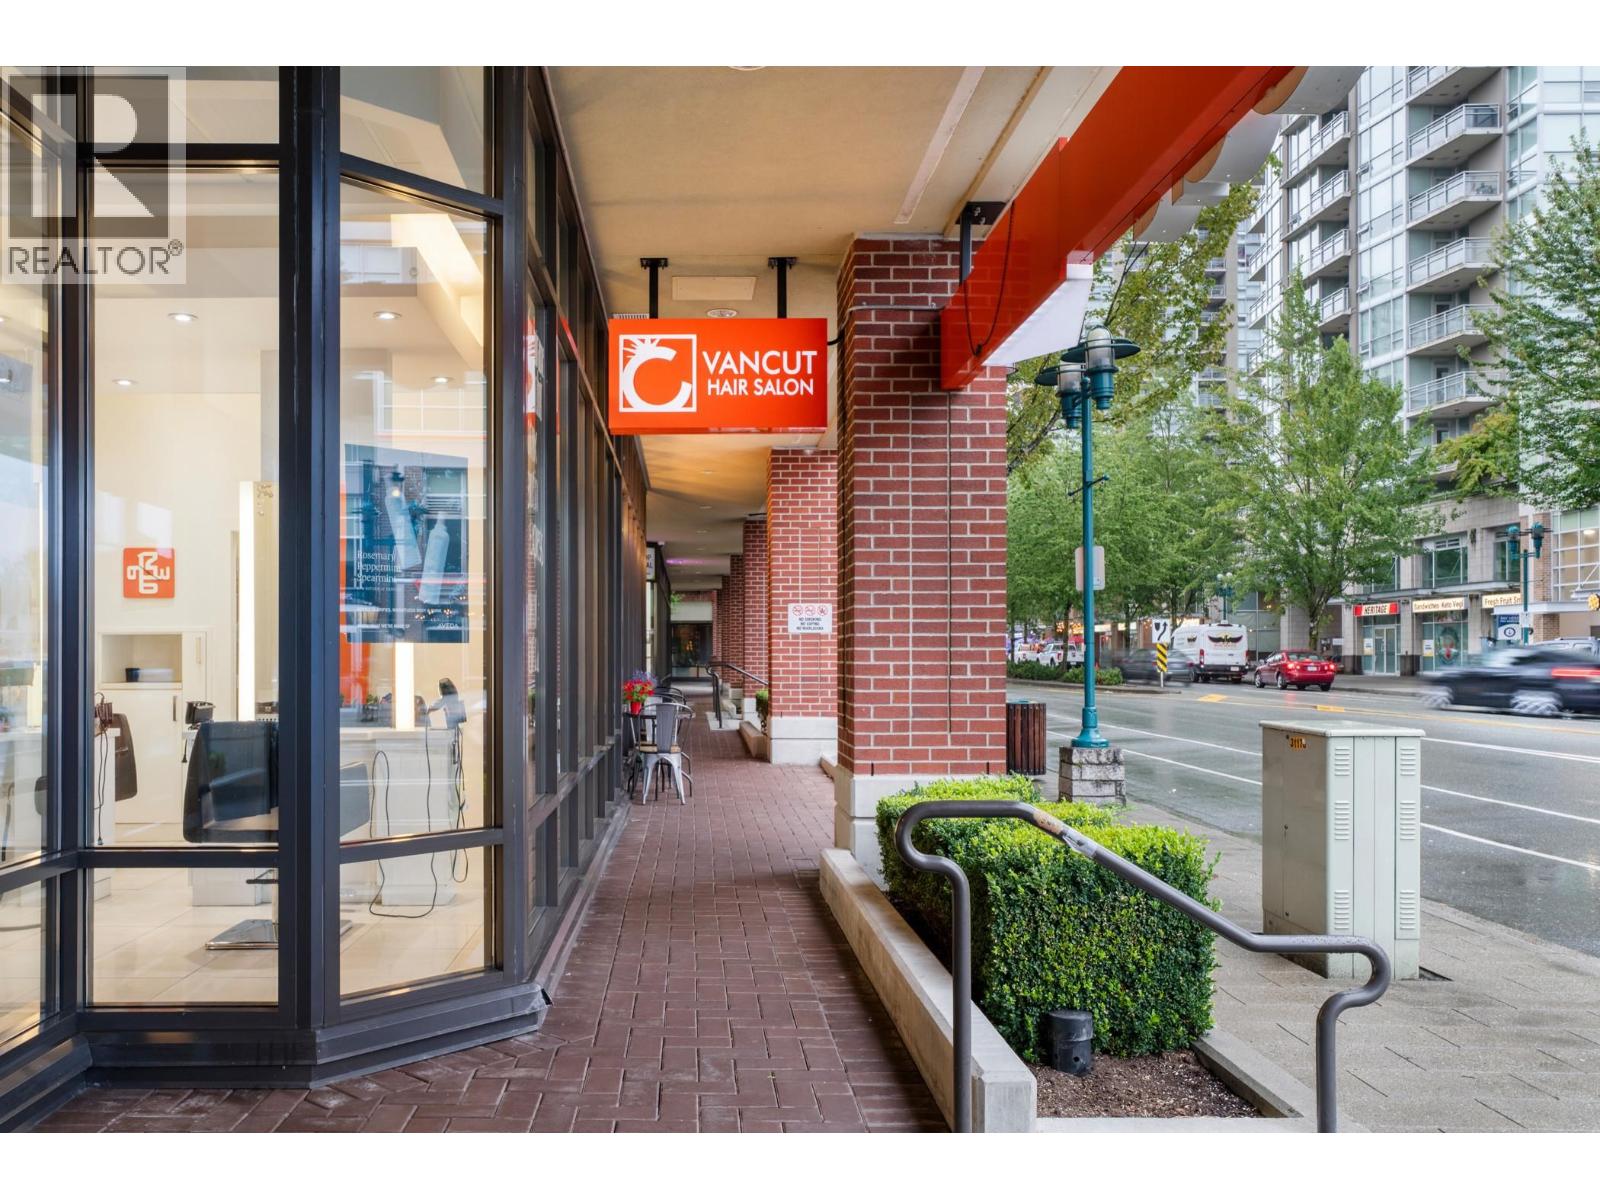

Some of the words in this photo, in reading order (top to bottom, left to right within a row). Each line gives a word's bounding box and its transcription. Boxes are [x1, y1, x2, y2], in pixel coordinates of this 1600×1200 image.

[702, 350, 817, 375] VANCUT
[707, 378, 749, 396] HAIR
[753, 378, 814, 396] SALON
[357, 550, 396, 562] Rosemary
[1484, 597, 1499, 606] Fresh
[1500, 597, 1512, 605] Fruit
[1364, 605, 1388, 615] HERITAGE
